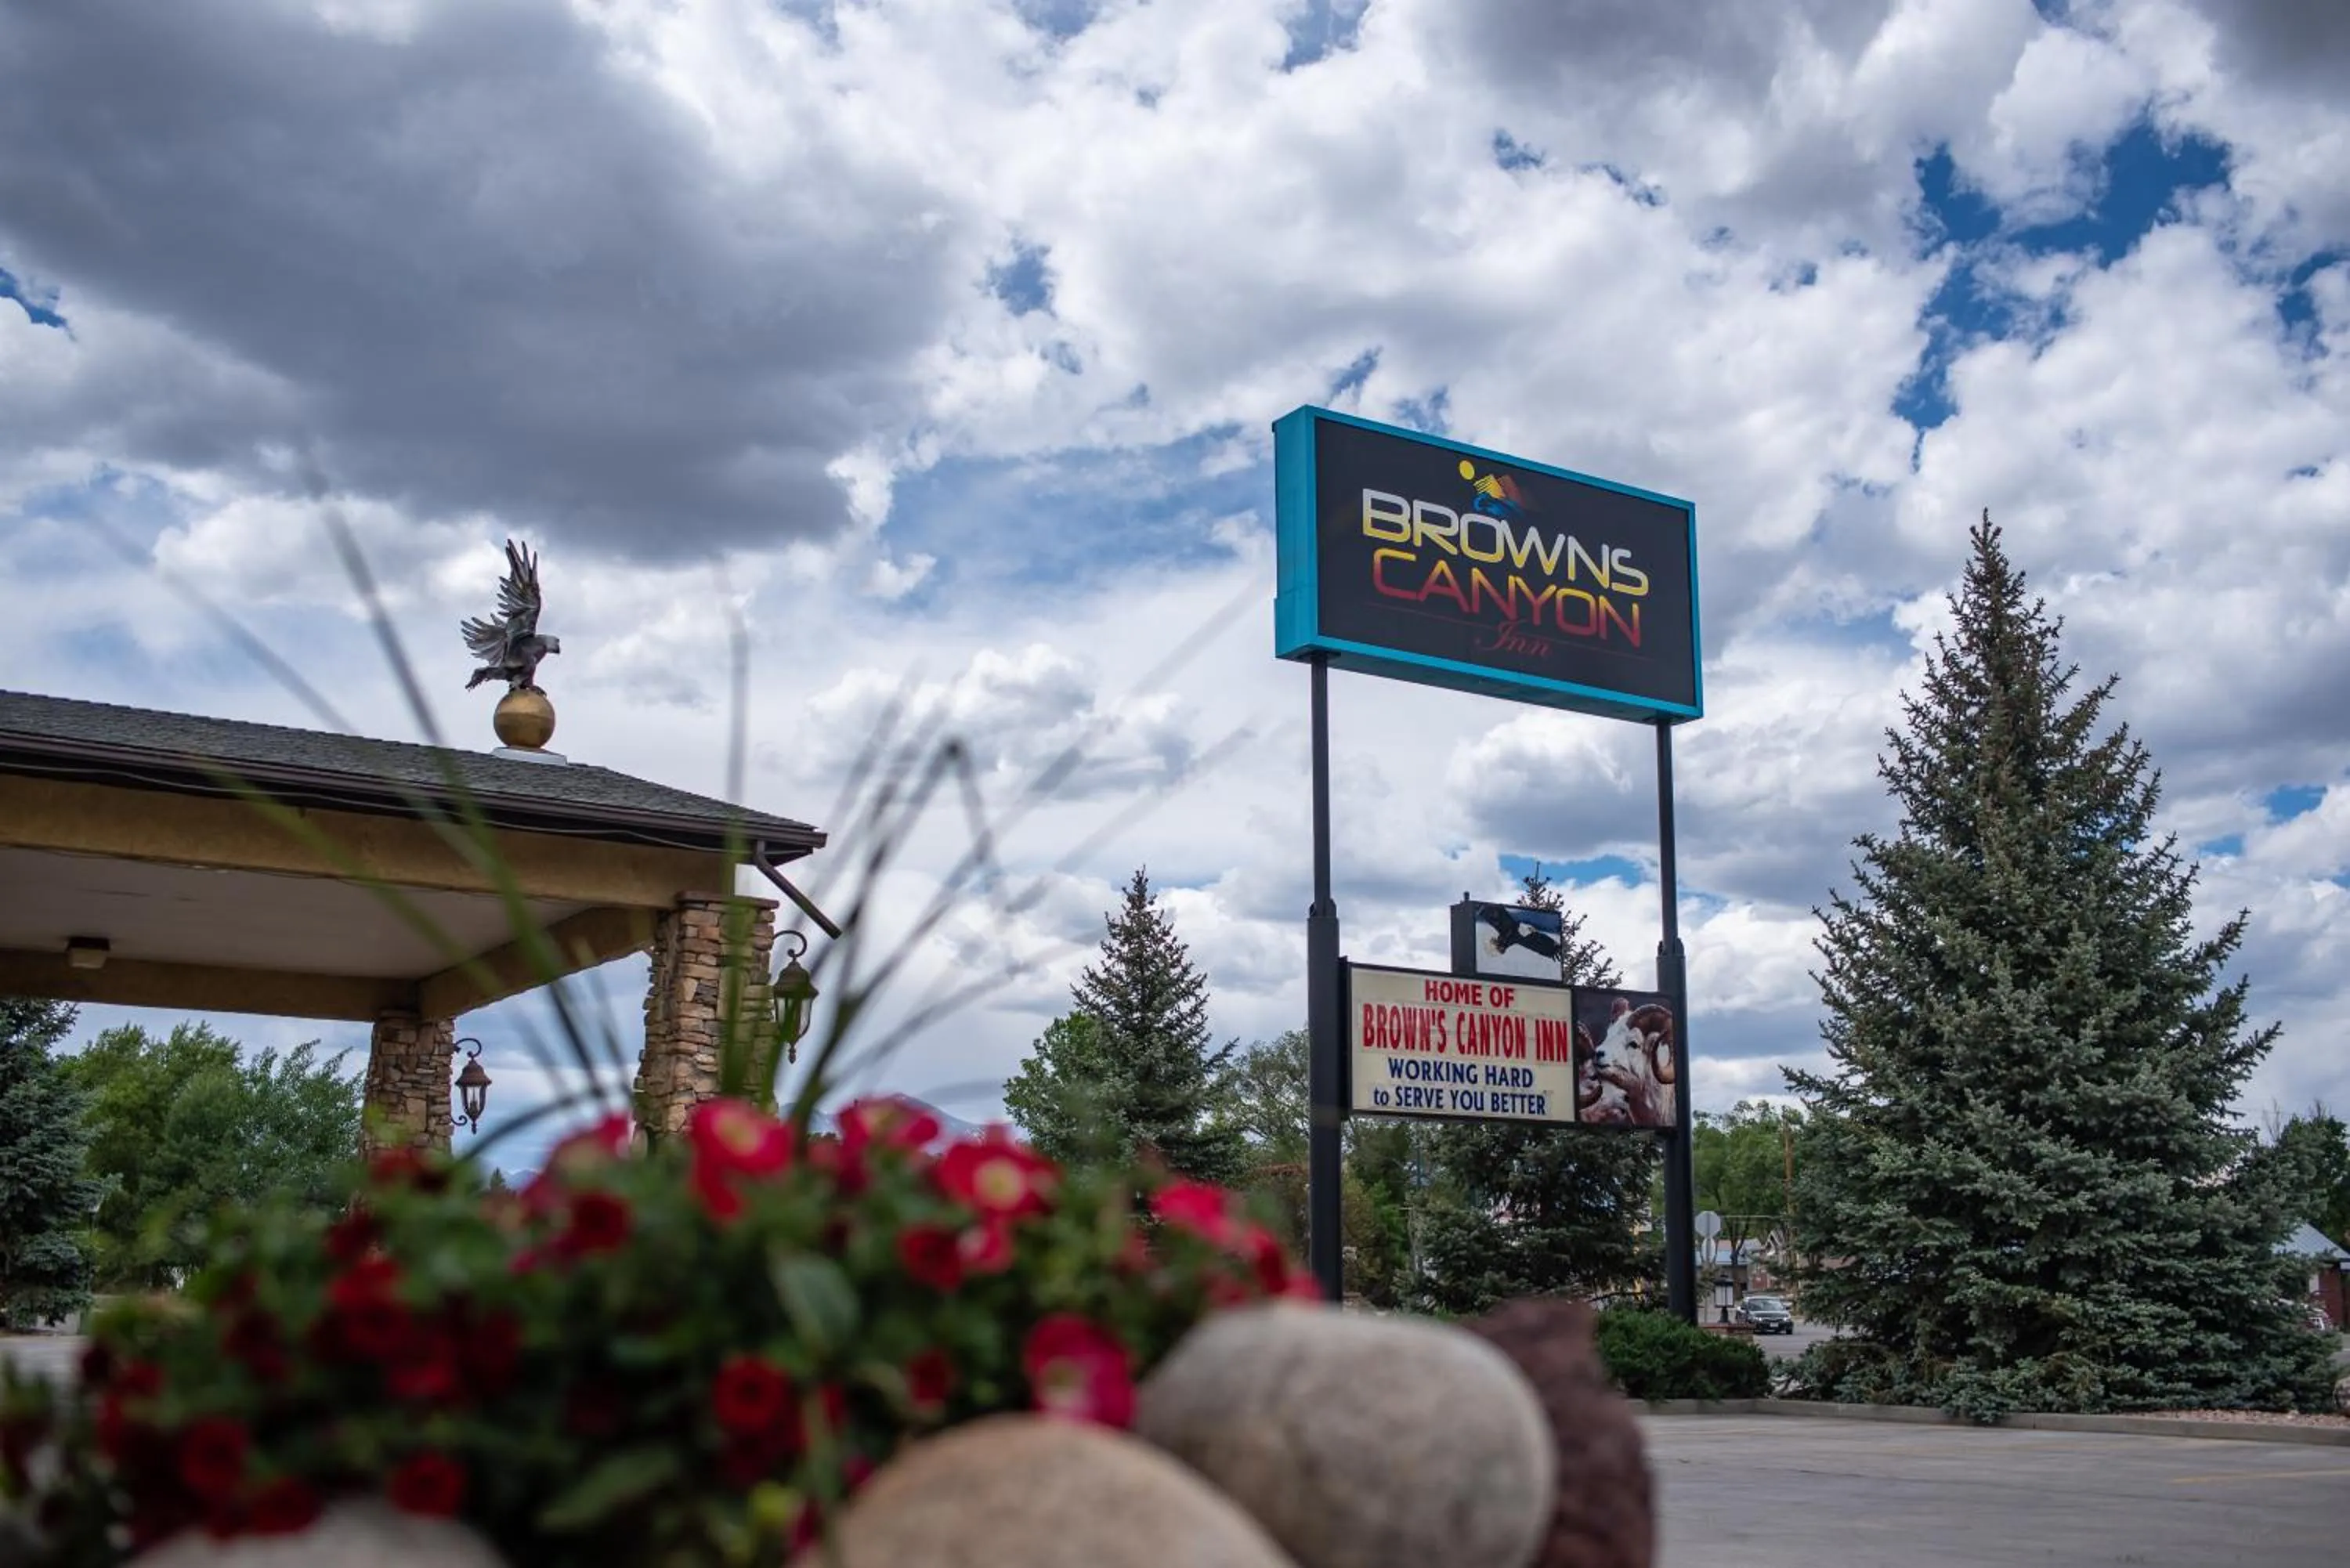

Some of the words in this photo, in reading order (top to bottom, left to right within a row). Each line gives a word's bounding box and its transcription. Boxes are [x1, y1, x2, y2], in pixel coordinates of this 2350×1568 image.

[1362, 488, 1649, 596] BROWNS
[1372, 548, 1640, 648] CANYON
[1474, 619, 1551, 658] Inn
[1425, 979, 1482, 1006] HOME
[1489, 986, 1515, 1007] OF
[1362, 1003, 1448, 1054] BROWN'S
[1456, 1011, 1527, 1059] CANYON
[1535, 1019, 1567, 1062] INN
[1388, 1057, 1478, 1085] WORKING
[1484, 1066, 1533, 1088] HARD
[1373, 1086, 1390, 1107] to
[1395, 1086, 1444, 1111] SERVE
[1450, 1090, 1485, 1111] YOU
[1491, 1093, 1546, 1115] BETTER
